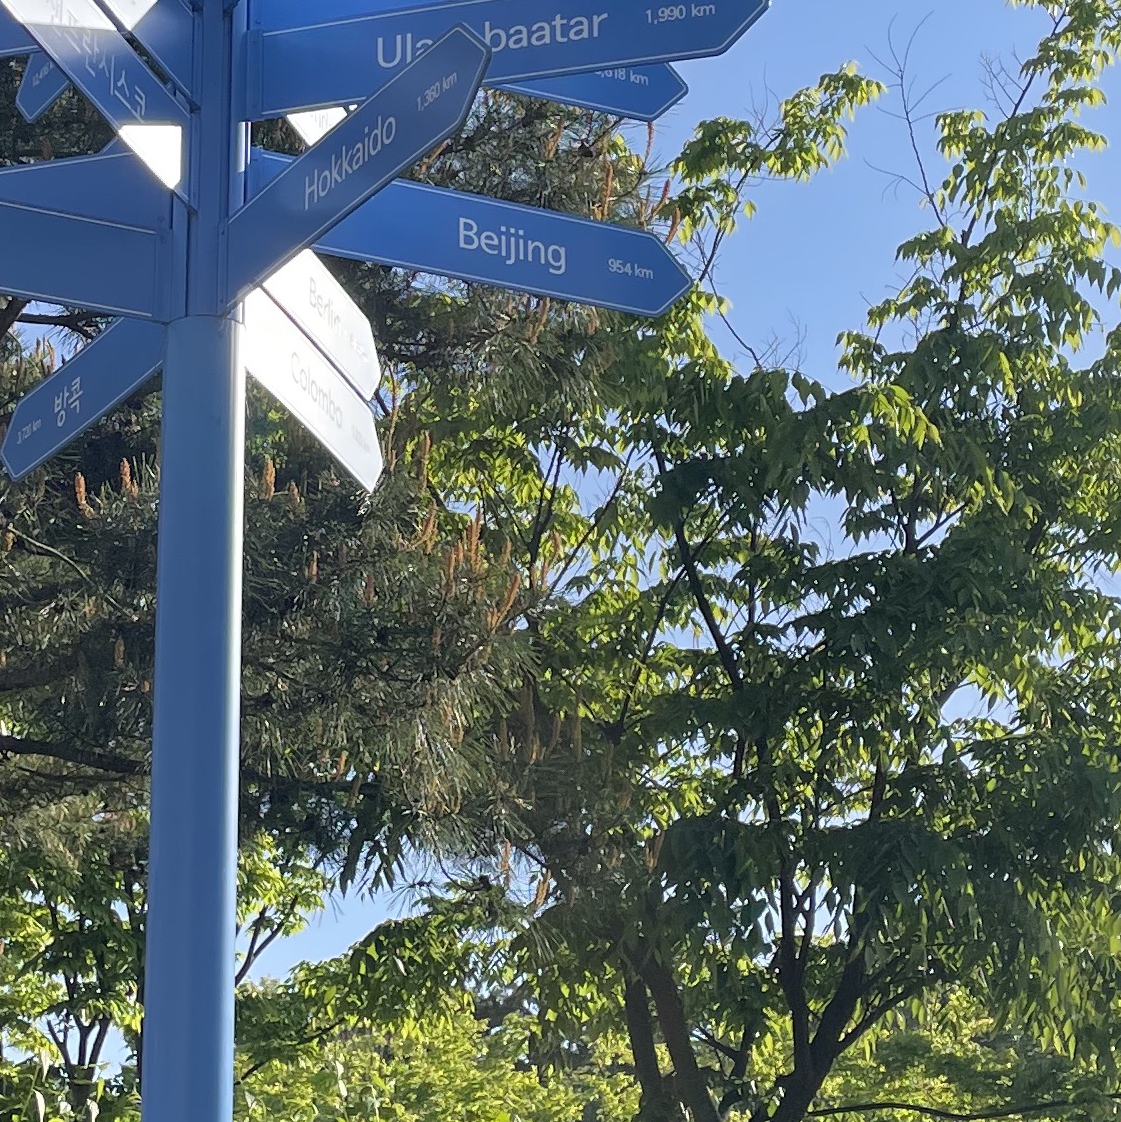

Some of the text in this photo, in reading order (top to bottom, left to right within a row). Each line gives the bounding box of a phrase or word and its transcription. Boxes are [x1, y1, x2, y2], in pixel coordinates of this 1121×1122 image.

[645, 3, 716, 25] 1,990 km
[416, 72, 458, 112] 1,360 km
[629, 69, 649, 86] km
[303, 114, 397, 212] Hokkaido
[458, 217, 567, 276] Beijing
[608, 257, 654, 280] 954 km
[309, 276, 343, 337] Berlin
[53, 376, 84, 428] 방콕
[290, 351, 343, 429] Colombo
